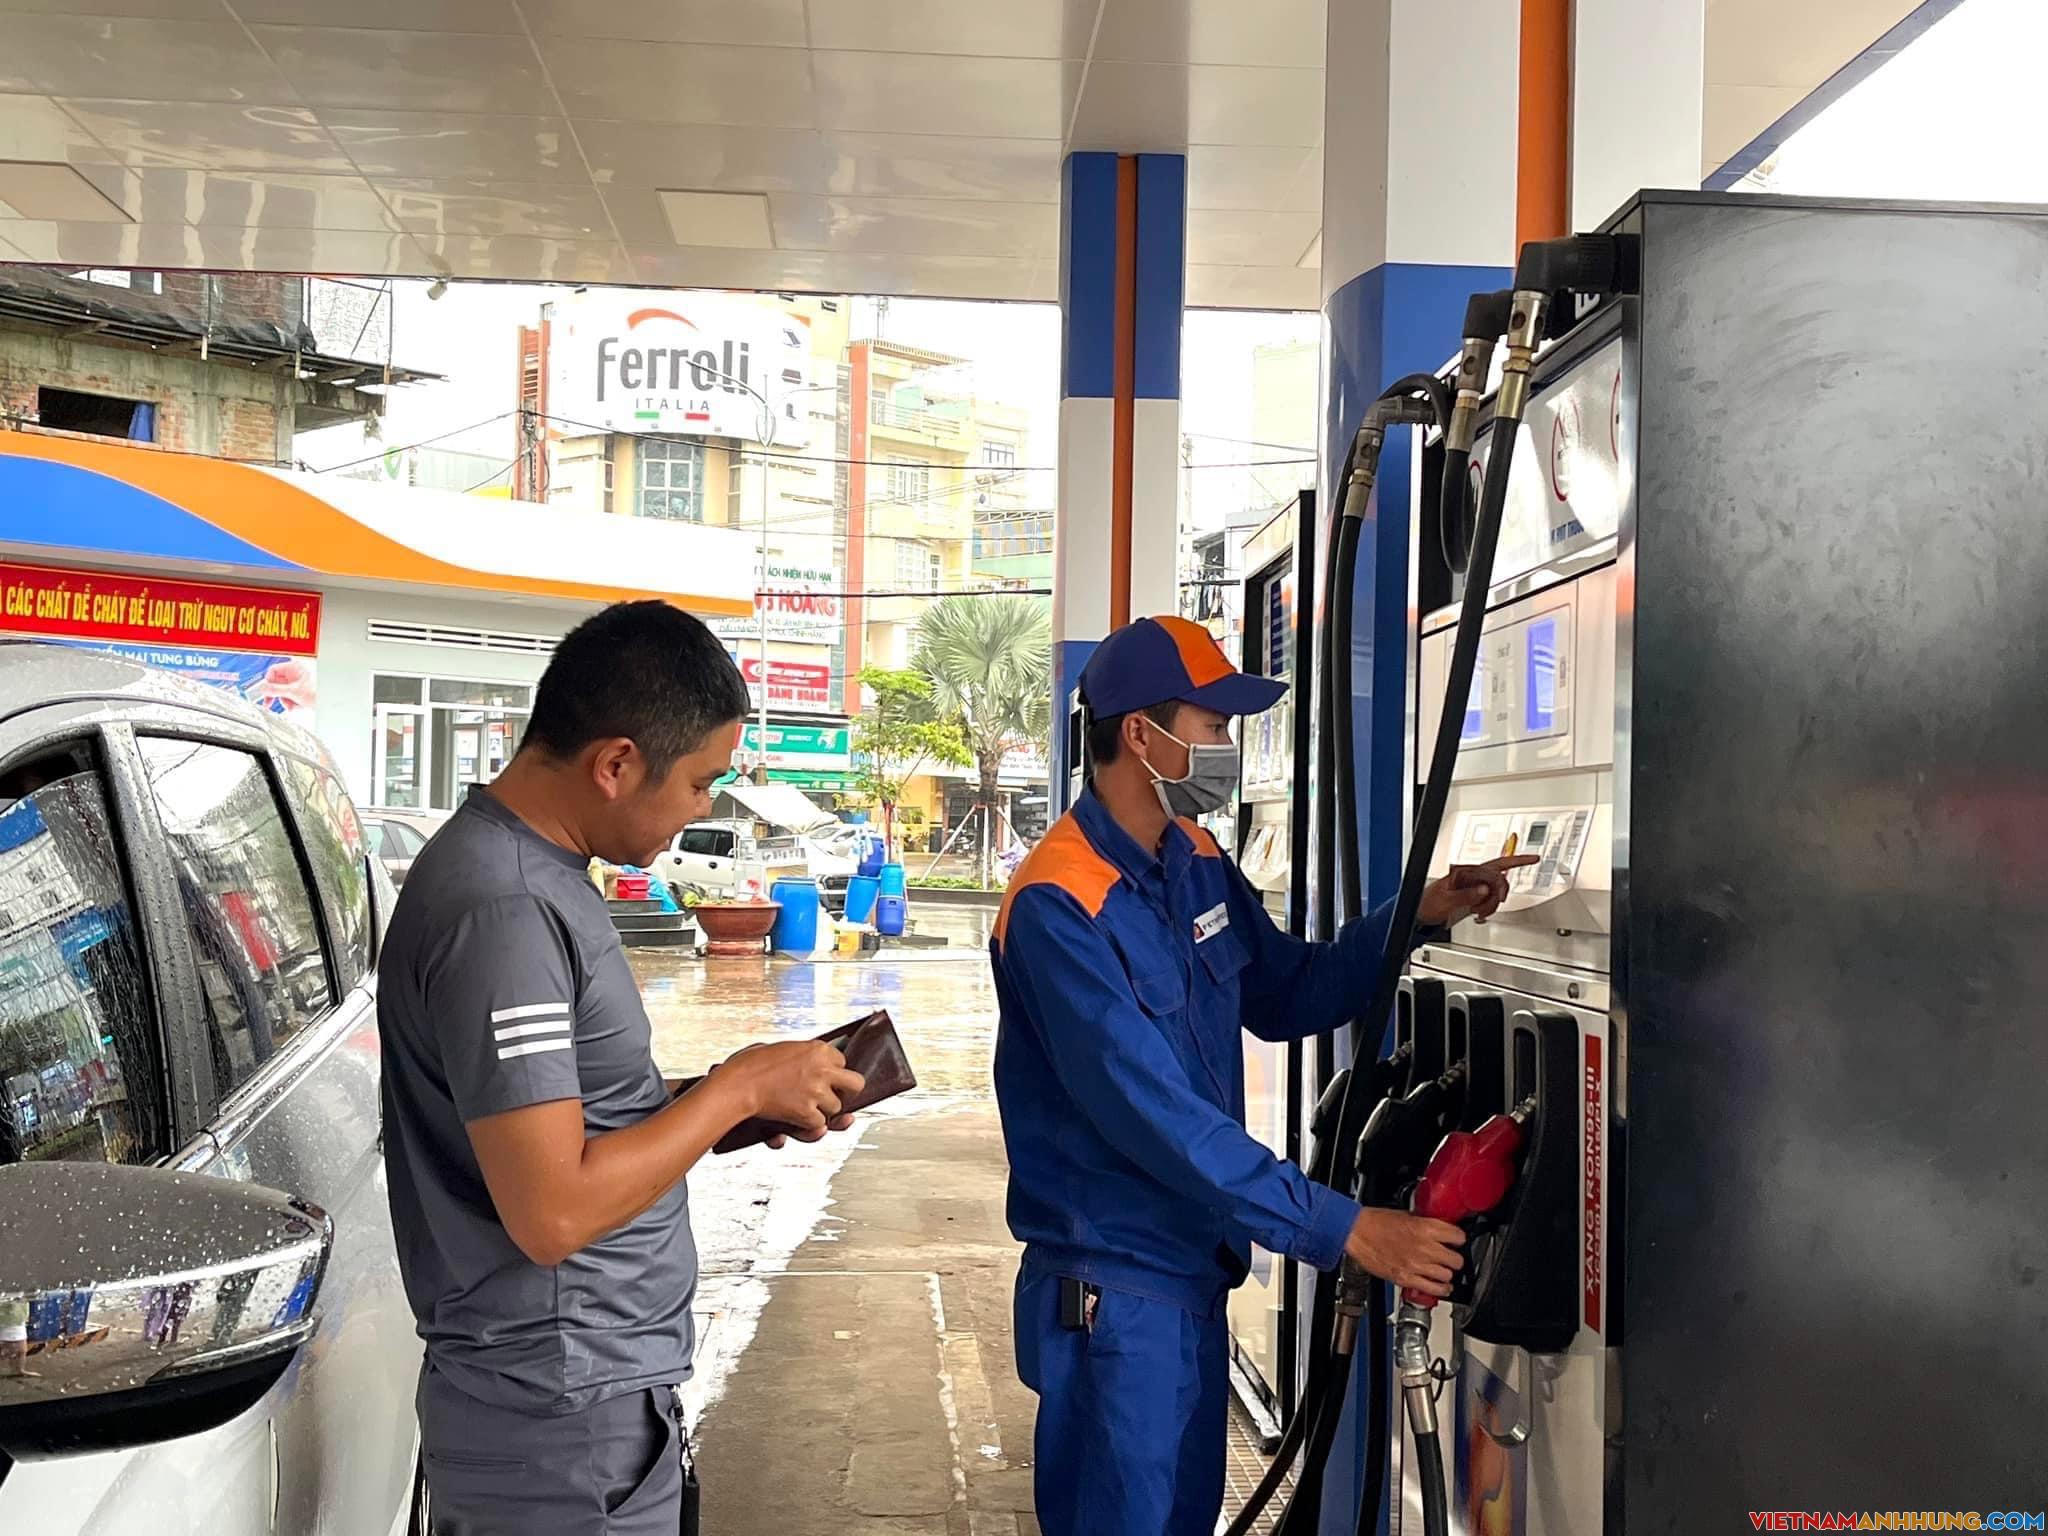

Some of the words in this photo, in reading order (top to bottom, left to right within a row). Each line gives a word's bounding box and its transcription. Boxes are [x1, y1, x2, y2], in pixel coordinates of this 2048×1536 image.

[635, 398, 710, 411] ITALIA
[6, 580, 33, 617] CÁC
[36, 580, 71, 620] CHẤT
[72, 583, 92, 622] DỄ
[93, 589, 127, 625] CHÁY
[128, 586, 149, 626] ĐỂ
[148, 598, 176, 635] LOẠI
[179, 597, 204, 632] TRỪ
[203, 604, 236, 633] NGUY
[238, 604, 256, 635] CƠ
[256, 604, 289, 641] CHÁY,
[290, 602, 310, 640] NỔ.
[778, 584, 836, 617] HOÀNG
[151, 653, 183, 665] TUNG
[1586, 1066, 1595, 1199] RON95-III
